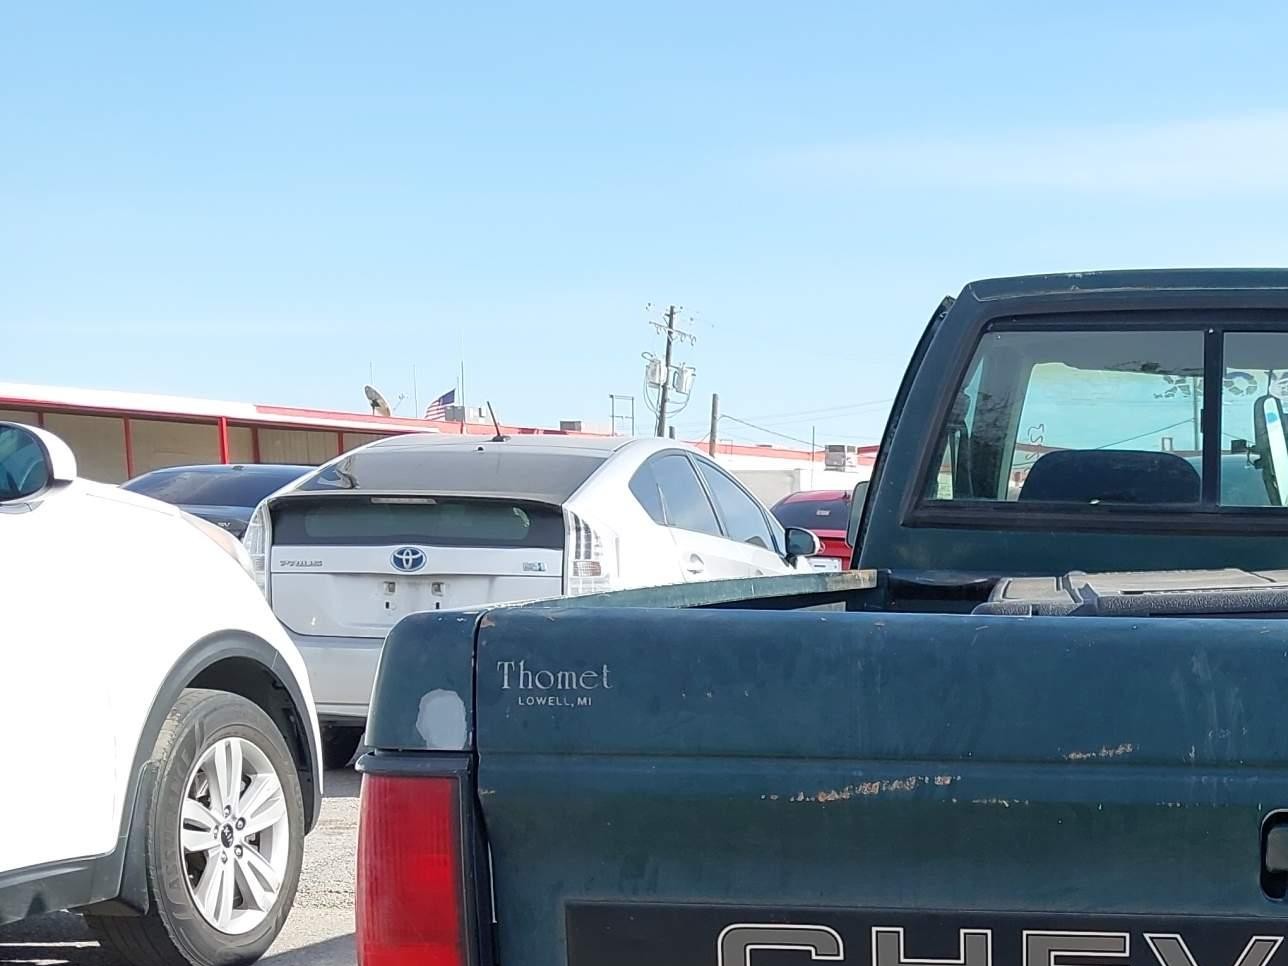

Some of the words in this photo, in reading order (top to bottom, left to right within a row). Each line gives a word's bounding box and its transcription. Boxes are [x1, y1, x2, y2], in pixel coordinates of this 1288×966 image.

[496, 659, 614, 690] Thomet
[518, 696, 575, 708] LOWELL,
[577, 696, 593, 706] MI
